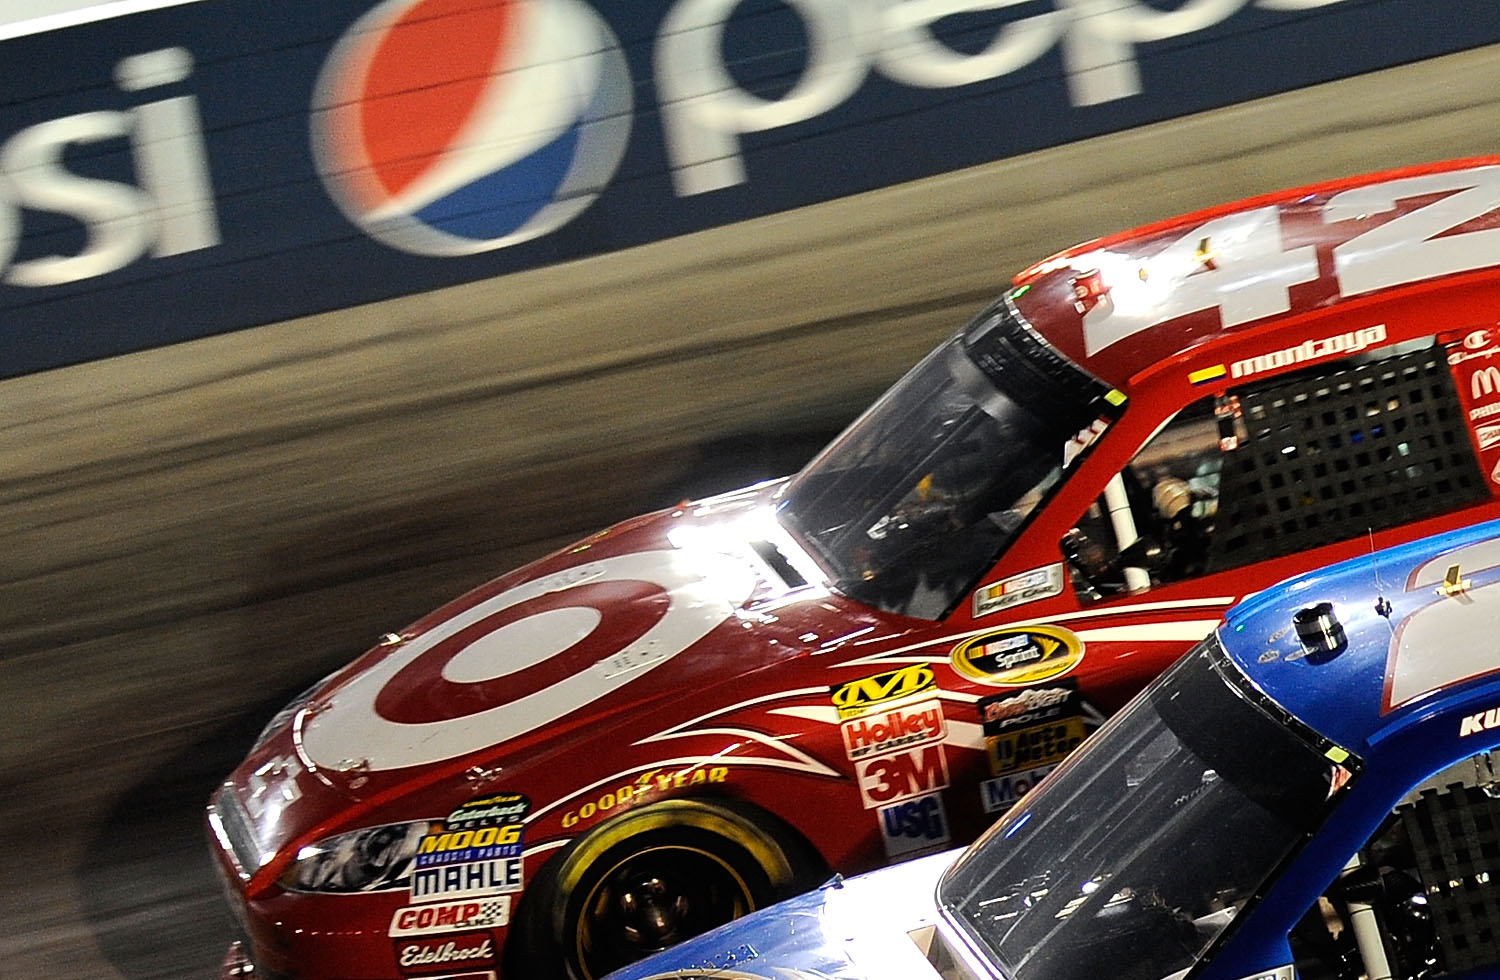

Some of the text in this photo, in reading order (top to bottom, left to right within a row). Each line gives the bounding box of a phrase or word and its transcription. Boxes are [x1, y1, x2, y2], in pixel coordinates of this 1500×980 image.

[1230, 323, 1388, 379] montoya
[995, 646, 1040, 669] Sprint
[847, 708, 939, 748] Holley
[864, 744, 945, 802] 3M
[884, 796, 944, 839] USG
[419, 824, 524, 854] MOOG
[414, 858, 521, 897] MAHLE
[398, 903, 480, 930] COMP
[400, 939, 495, 967] Edelbrock
